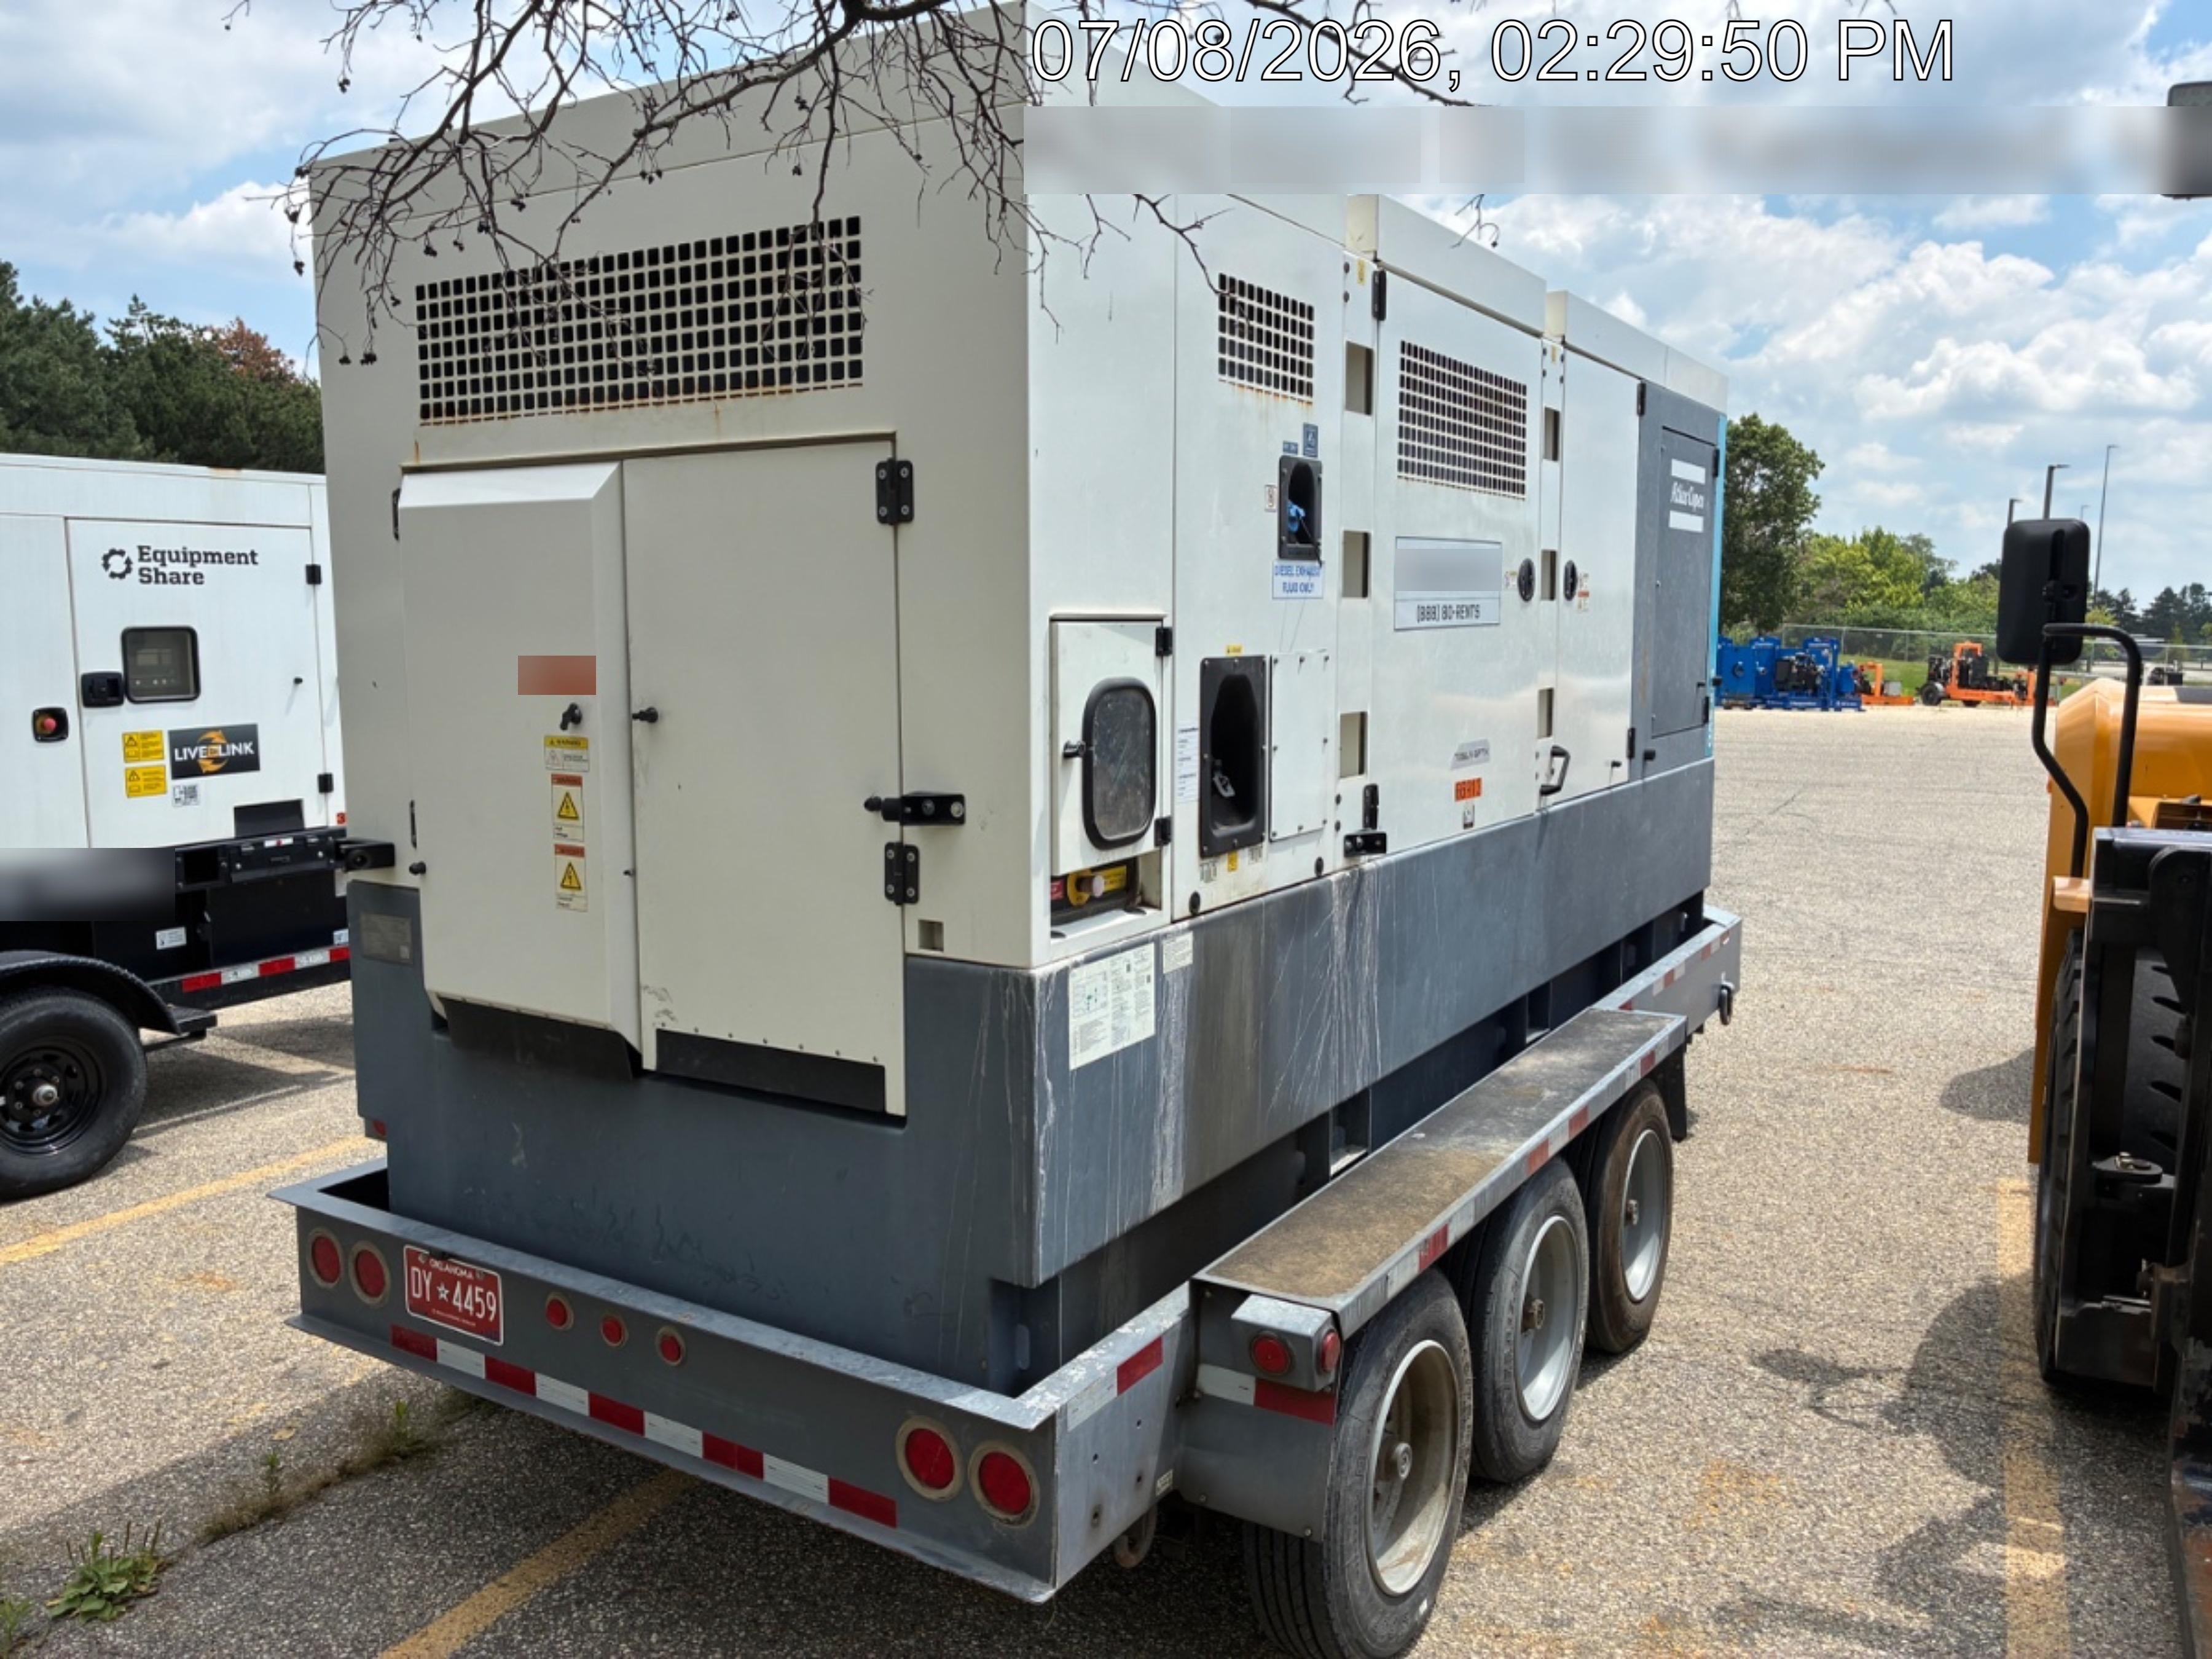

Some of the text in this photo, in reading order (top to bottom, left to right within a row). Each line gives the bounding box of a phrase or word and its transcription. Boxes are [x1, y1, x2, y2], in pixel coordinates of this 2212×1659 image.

[136, 544, 259, 568] Equipment
[138, 567, 205, 584] Share
[175, 745, 207, 762] LIVE
[219, 741, 255, 756] LINK
[429, 1258, 474, 1279] OKLAHOMA
[410, 1266, 433, 1303] DY
[452, 1280, 497, 1322] 4459
